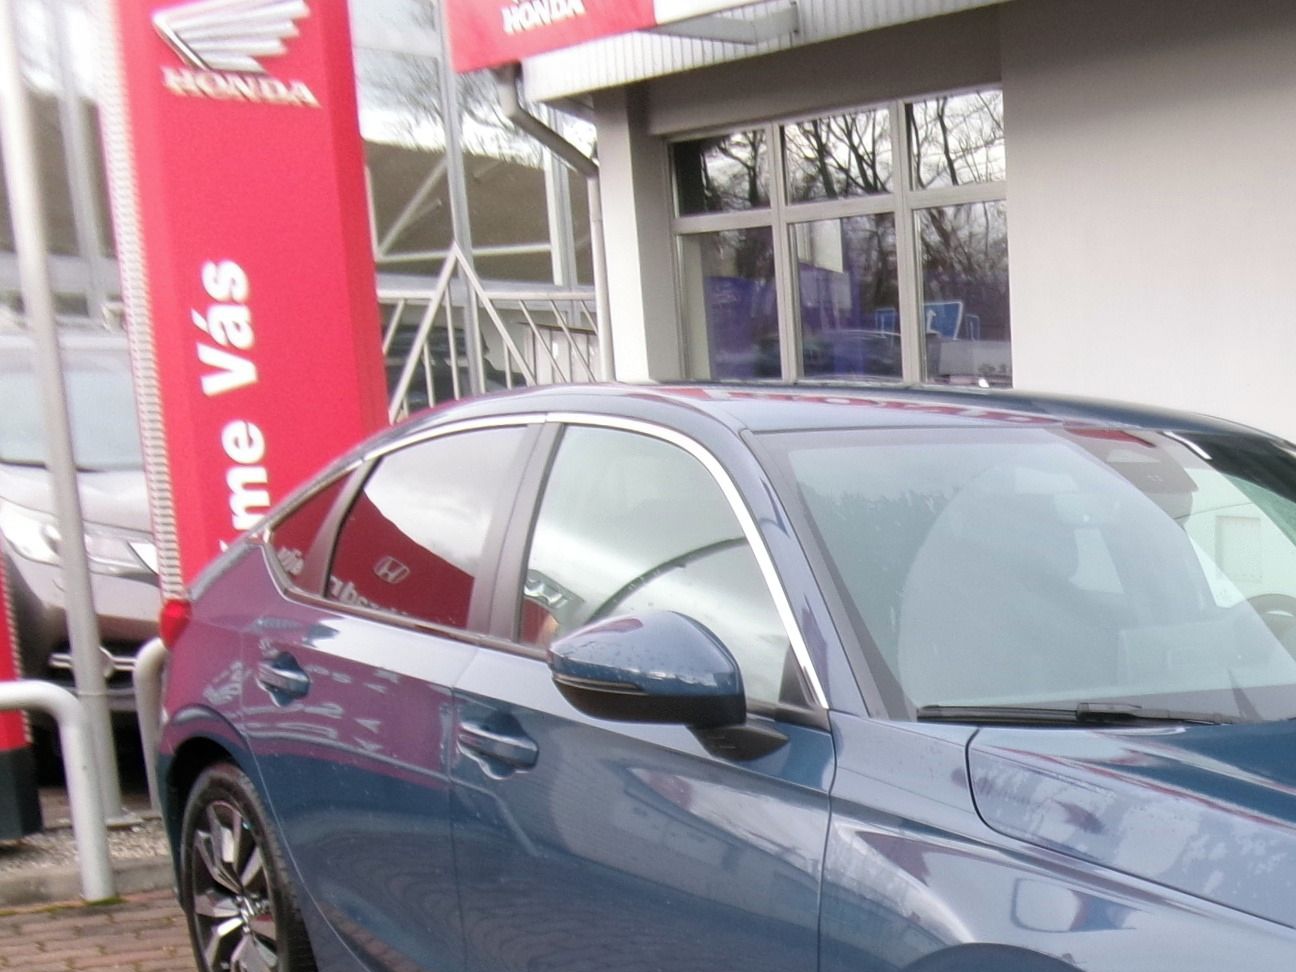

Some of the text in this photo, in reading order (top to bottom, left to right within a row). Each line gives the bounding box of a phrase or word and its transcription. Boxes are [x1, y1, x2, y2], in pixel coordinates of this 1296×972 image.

[501, 0, 586, 33] HONDA
[160, 65, 322, 108] HONDA
[191, 259, 258, 397] Vás
